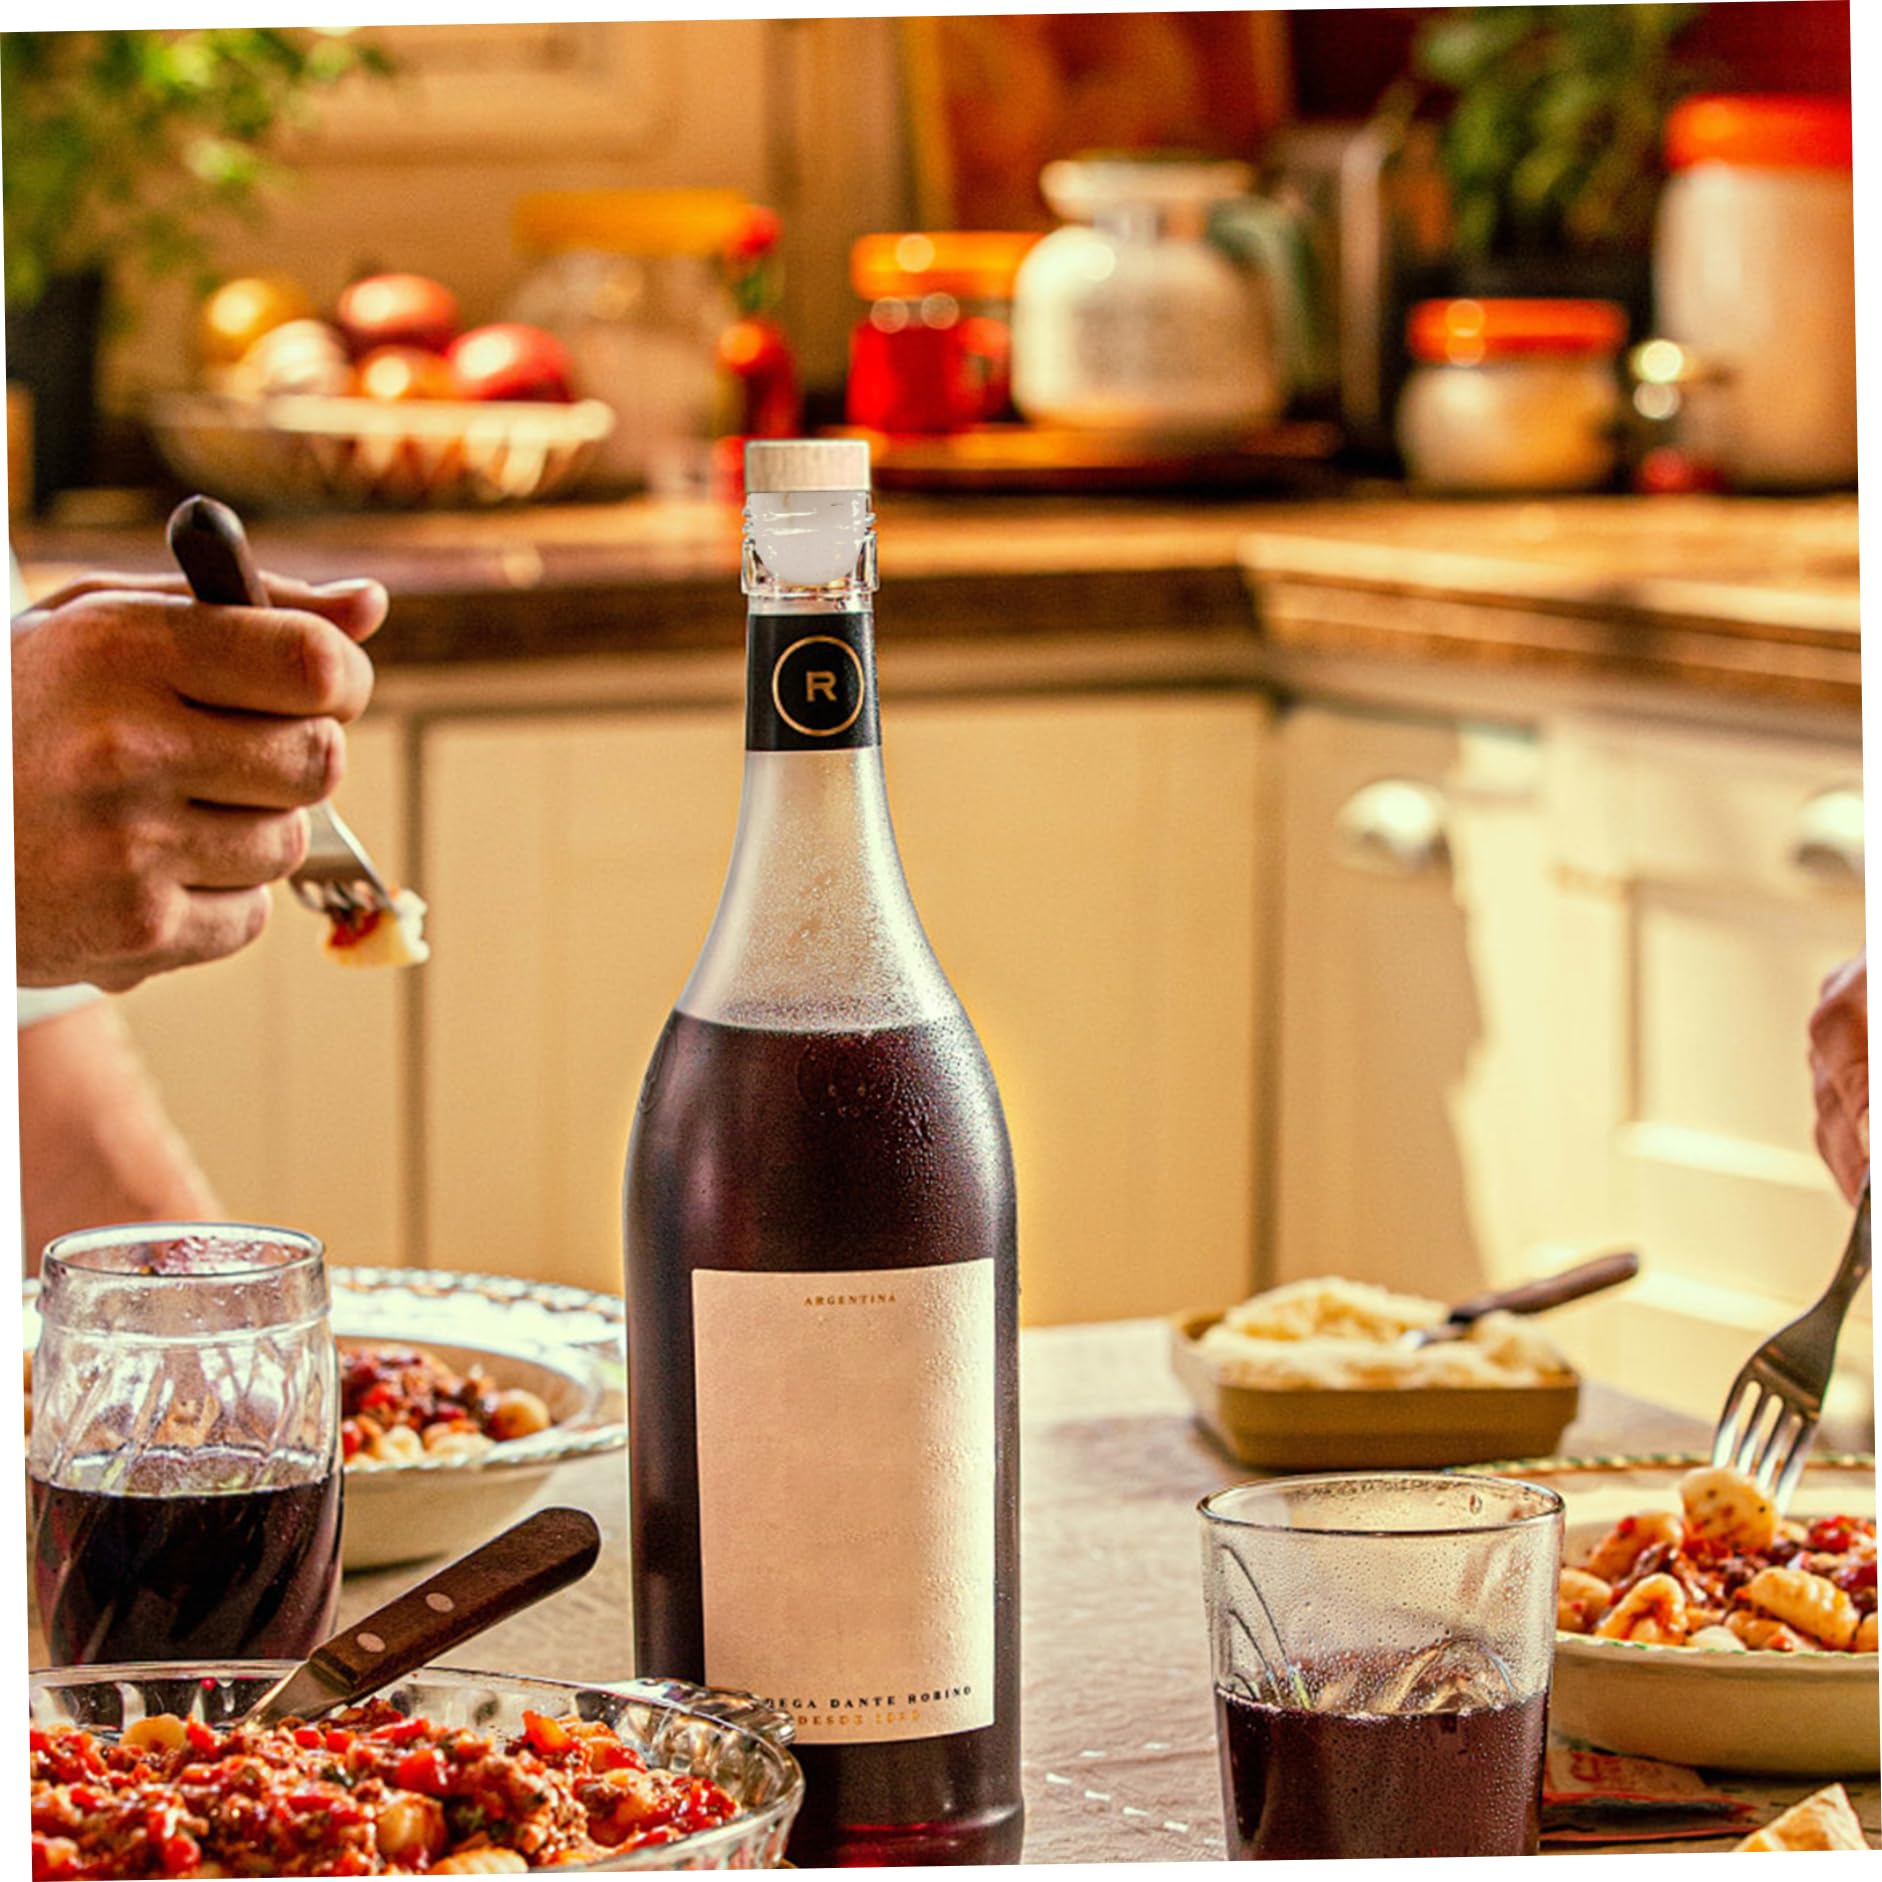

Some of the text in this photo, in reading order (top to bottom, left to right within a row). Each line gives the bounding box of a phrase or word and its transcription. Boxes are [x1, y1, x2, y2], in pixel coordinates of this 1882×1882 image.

[805, 670, 838, 703] R
[804, 1293, 896, 1306] ARGENTINA
[766, 1686, 971, 1709] DEGA DANTE ROBINO
